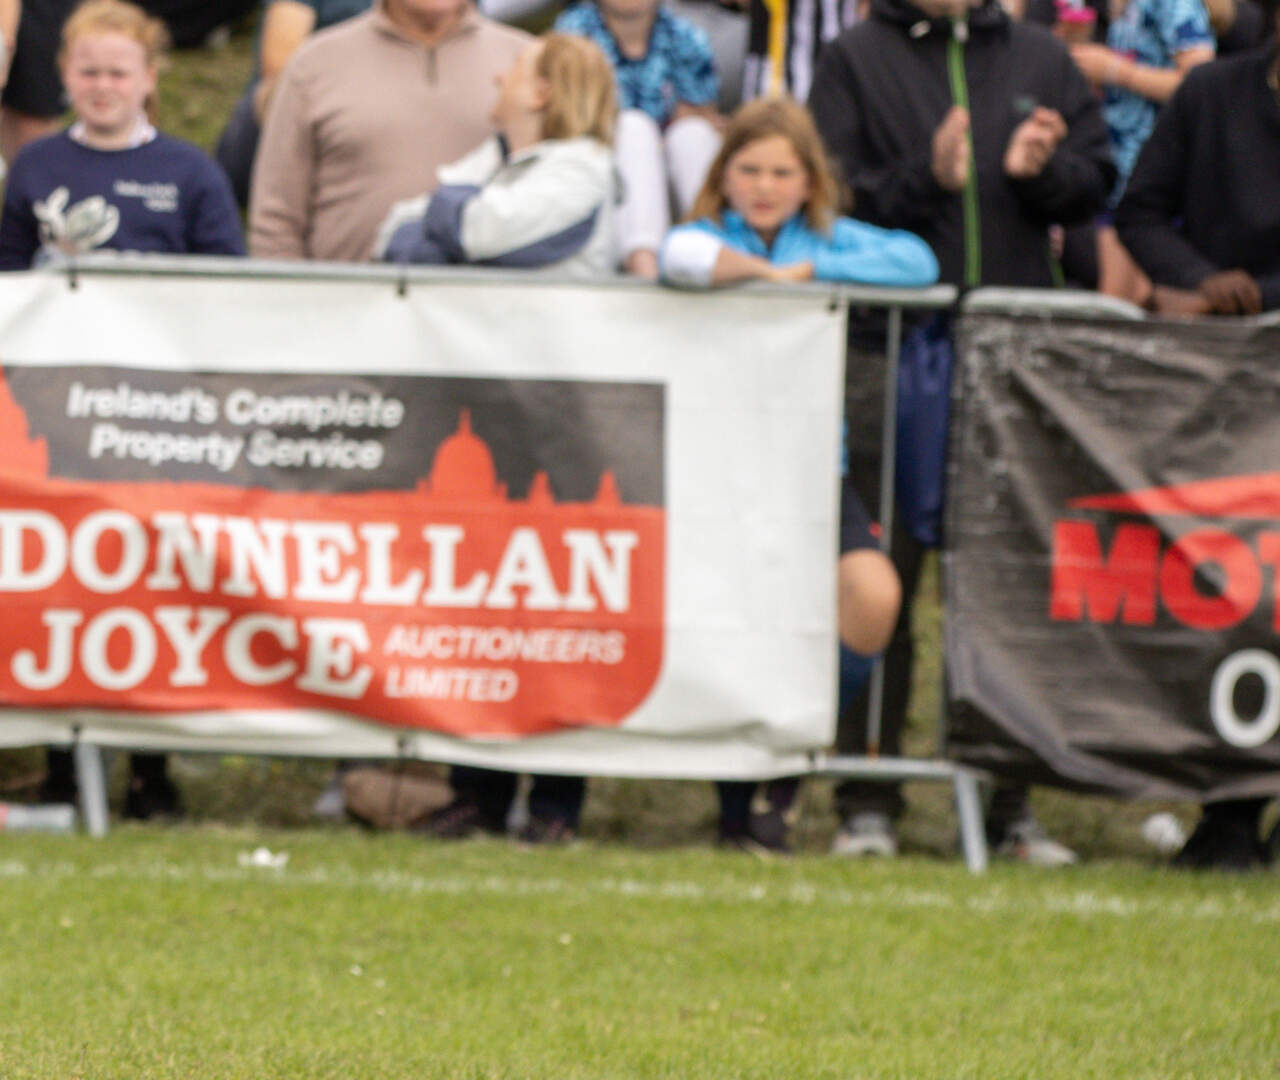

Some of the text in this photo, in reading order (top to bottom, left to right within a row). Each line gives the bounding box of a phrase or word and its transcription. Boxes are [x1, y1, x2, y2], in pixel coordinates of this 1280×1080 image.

[66, 381, 406, 433] Ireland's Complete
[88, 422, 387, 471] Property Service
[1049, 520, 1280, 634] MO
[10, 606, 372, 700] JOYCE
[382, 624, 627, 665] AUCTIONEERS
[383, 666, 520, 703] LIMITED
